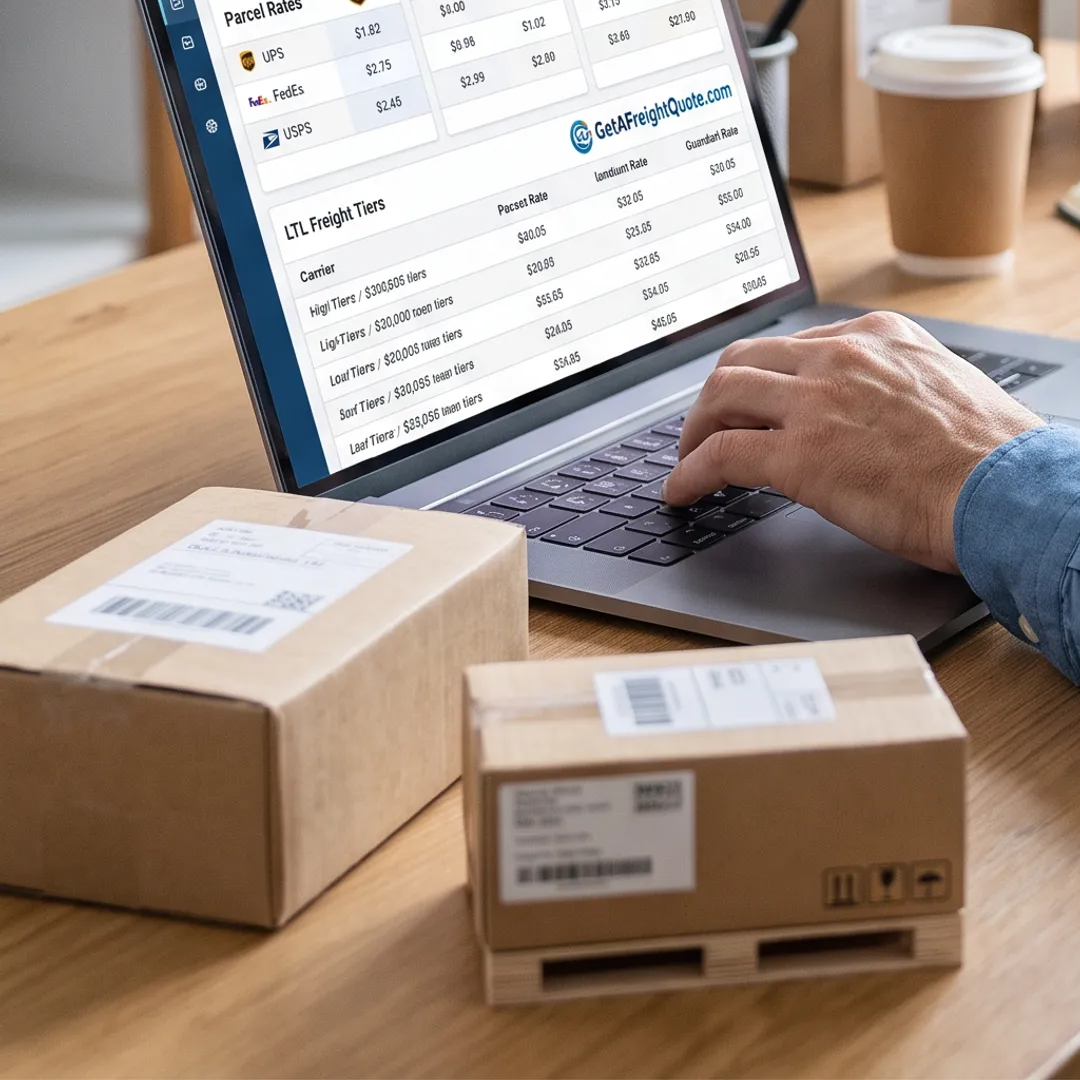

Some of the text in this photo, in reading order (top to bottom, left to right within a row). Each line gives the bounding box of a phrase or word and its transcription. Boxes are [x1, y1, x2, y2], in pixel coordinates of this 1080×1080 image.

[224, 2, 266, 27] Parcel
[355, 22, 381, 40] $1.82
[522, 16, 546, 32] $1.02
[262, 47, 284, 63] UPS
[365, 59, 392, 76] $2.75
[460, 71, 485, 89] $2.99
[272, 84, 304, 102] FedEs
[376, 96, 402, 113] $2.45
[594, 84, 733, 140] GetAFreightQuote.com
[283, 121, 312, 140] USPS
[628, 158, 648, 172] Rate
[528, 192, 548, 205] Rate
[284, 199, 386, 240] LTL Freight Tiers
[300, 264, 335, 282] Carrier
[434, 296, 453, 310] tiers
[442, 329, 463, 343] tiers
[454, 361, 474, 375] tiers
[462, 394, 483, 408] tiers
